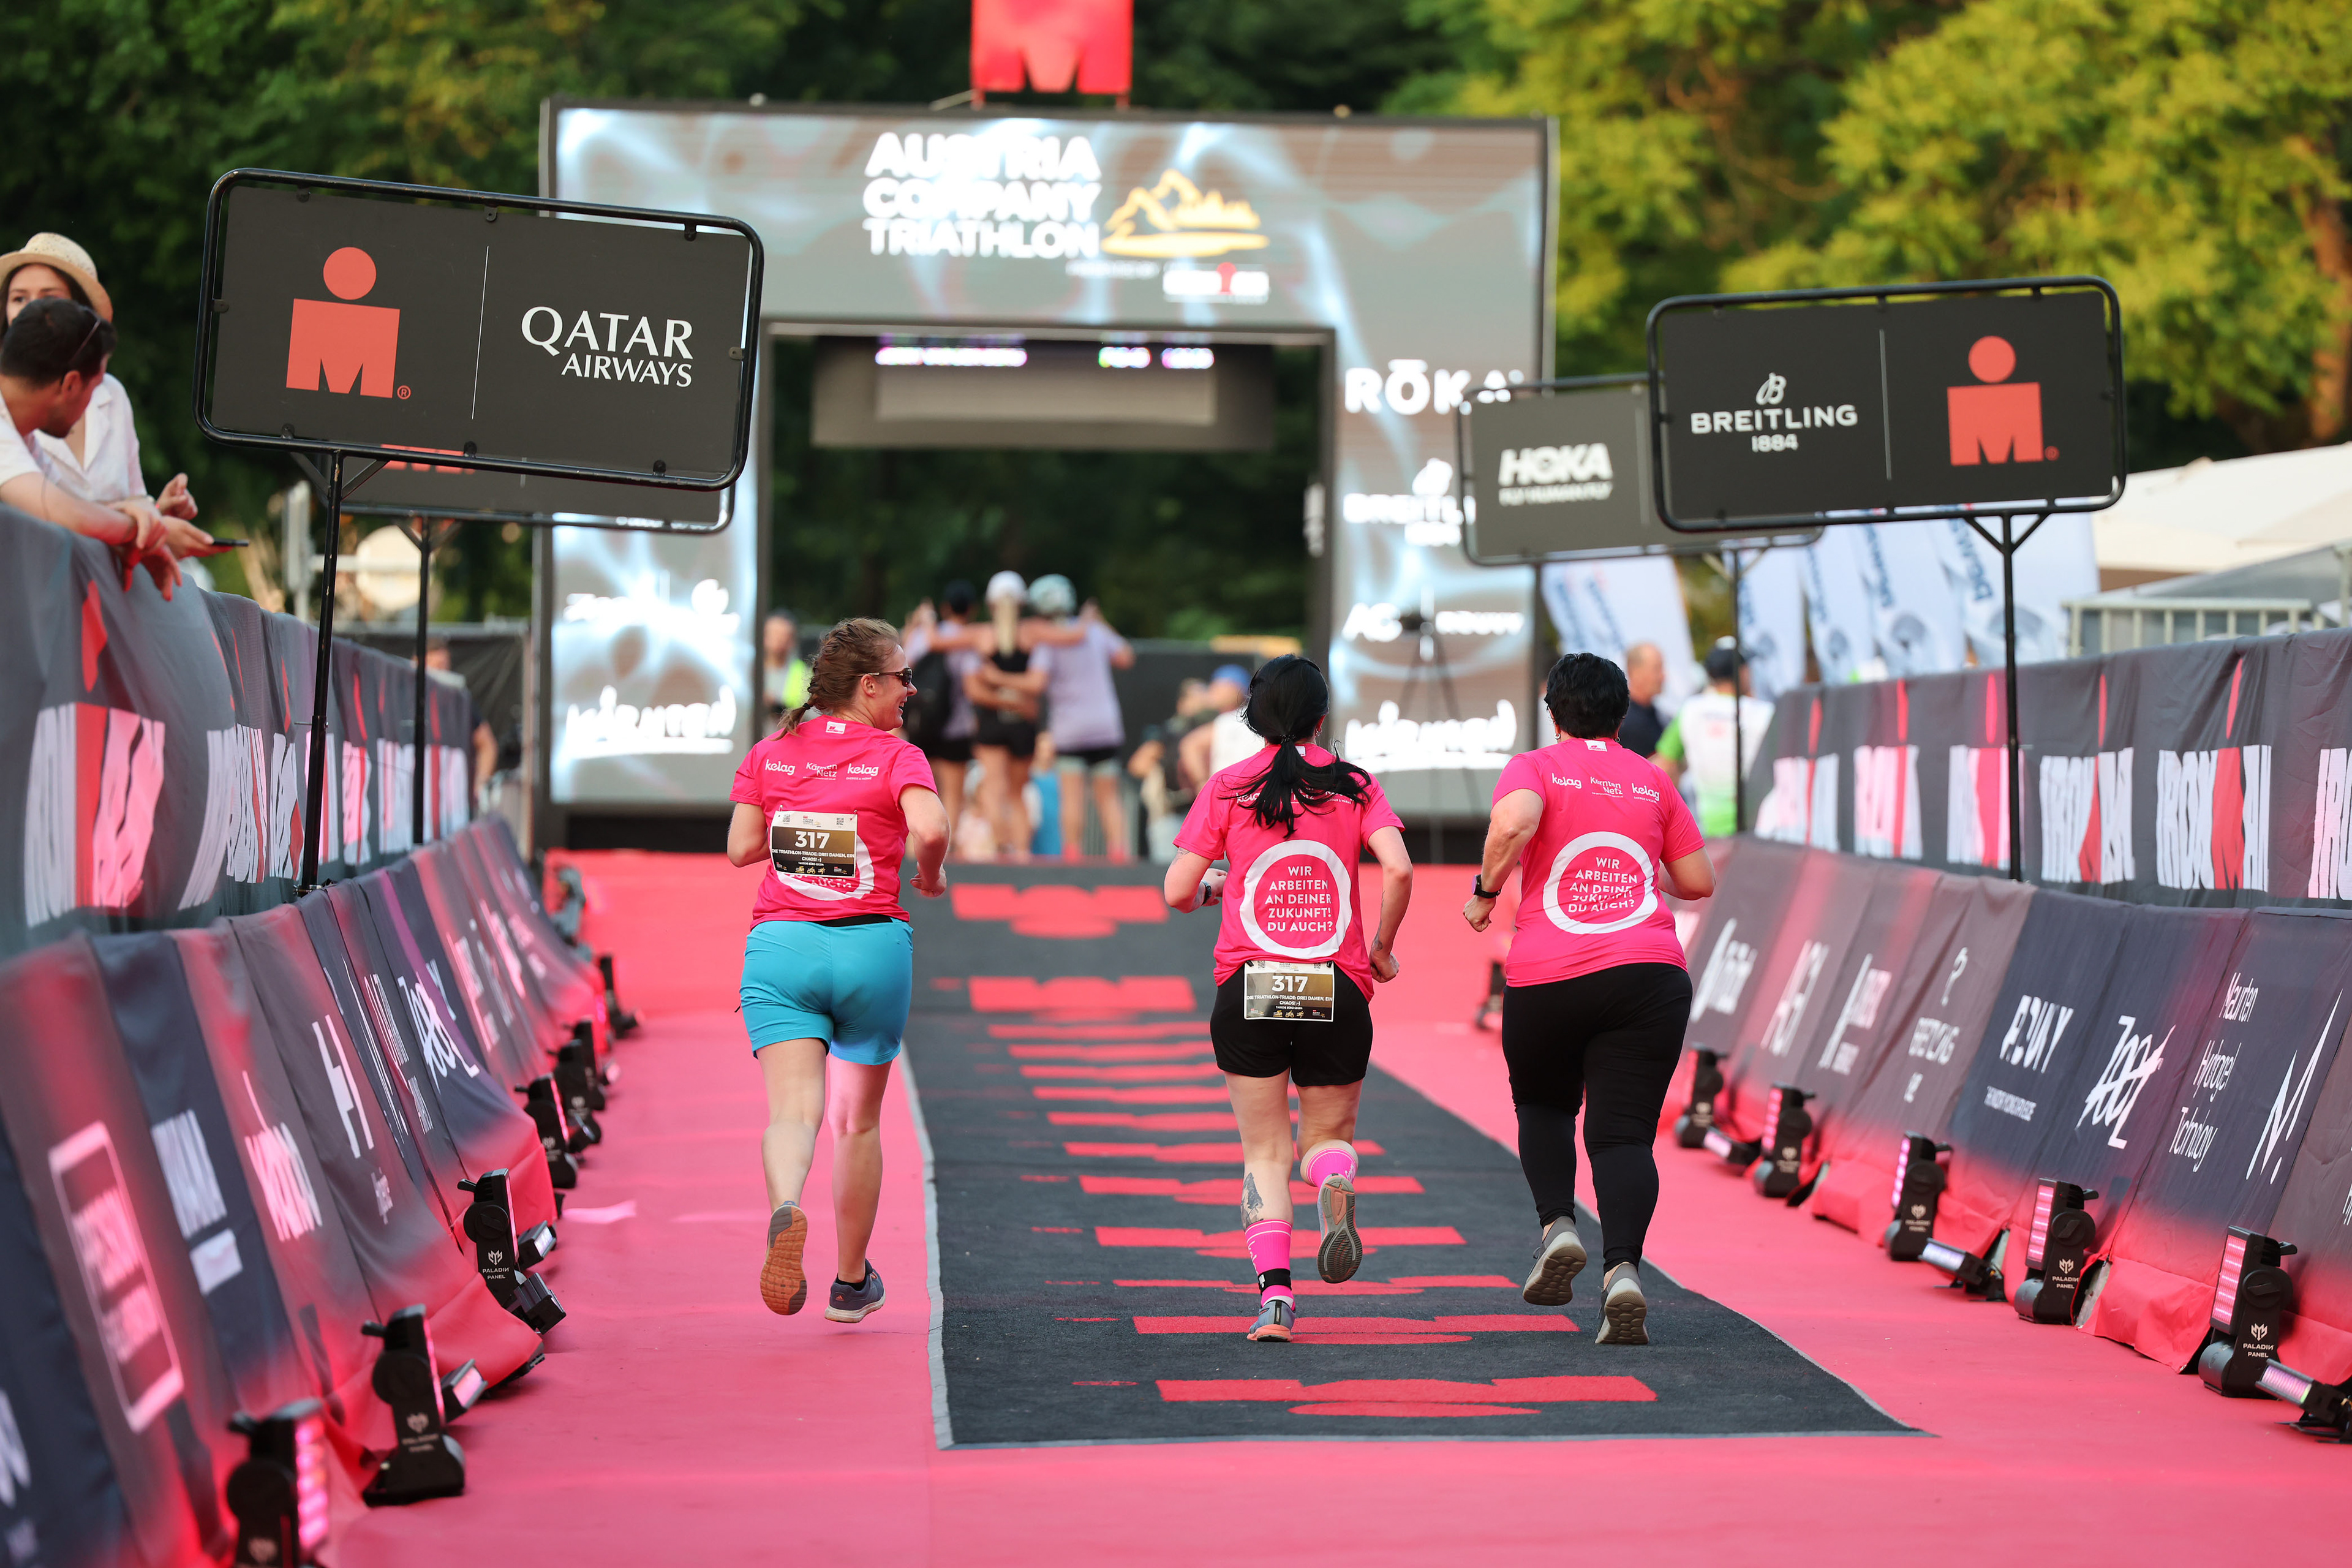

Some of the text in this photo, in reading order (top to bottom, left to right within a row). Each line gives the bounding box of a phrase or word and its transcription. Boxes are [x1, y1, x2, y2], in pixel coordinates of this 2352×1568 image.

[865, 132, 1102, 182] AUSTRIA
[863, 217, 1100, 259] TRIATHLON
[521, 306, 693, 360] QATAR
[561, 353, 693, 388] AIRWAYS
[1691, 404, 1858, 434] BREITLING
[1752, 434, 1798, 453] 1884
[1498, 442, 1613, 488] HOKA
[765, 759, 796, 775] kelag
[847, 763, 879, 777] kelag
[1551, 772, 1582, 789] kelag
[1603, 786, 1623, 795] Netz
[1631, 783, 1659, 801] kelag
[794, 831, 830, 849] 317
[1287, 866, 1312, 876] WIR
[1596, 857, 1620, 869] WIR
[1575, 869, 1637, 883] ARBEITEN
[1269, 880, 1329, 891] ARBEITEN
[1569, 882, 1589, 893] AN
[1265, 893, 1332, 905] AN DEINER
[1568, 899, 1635, 913] DU AUCH?
[1268, 908, 1332, 919] ZUKUNFT!
[1268, 921, 1333, 932] DU AUCH?
[1272, 975, 1308, 992] 317
